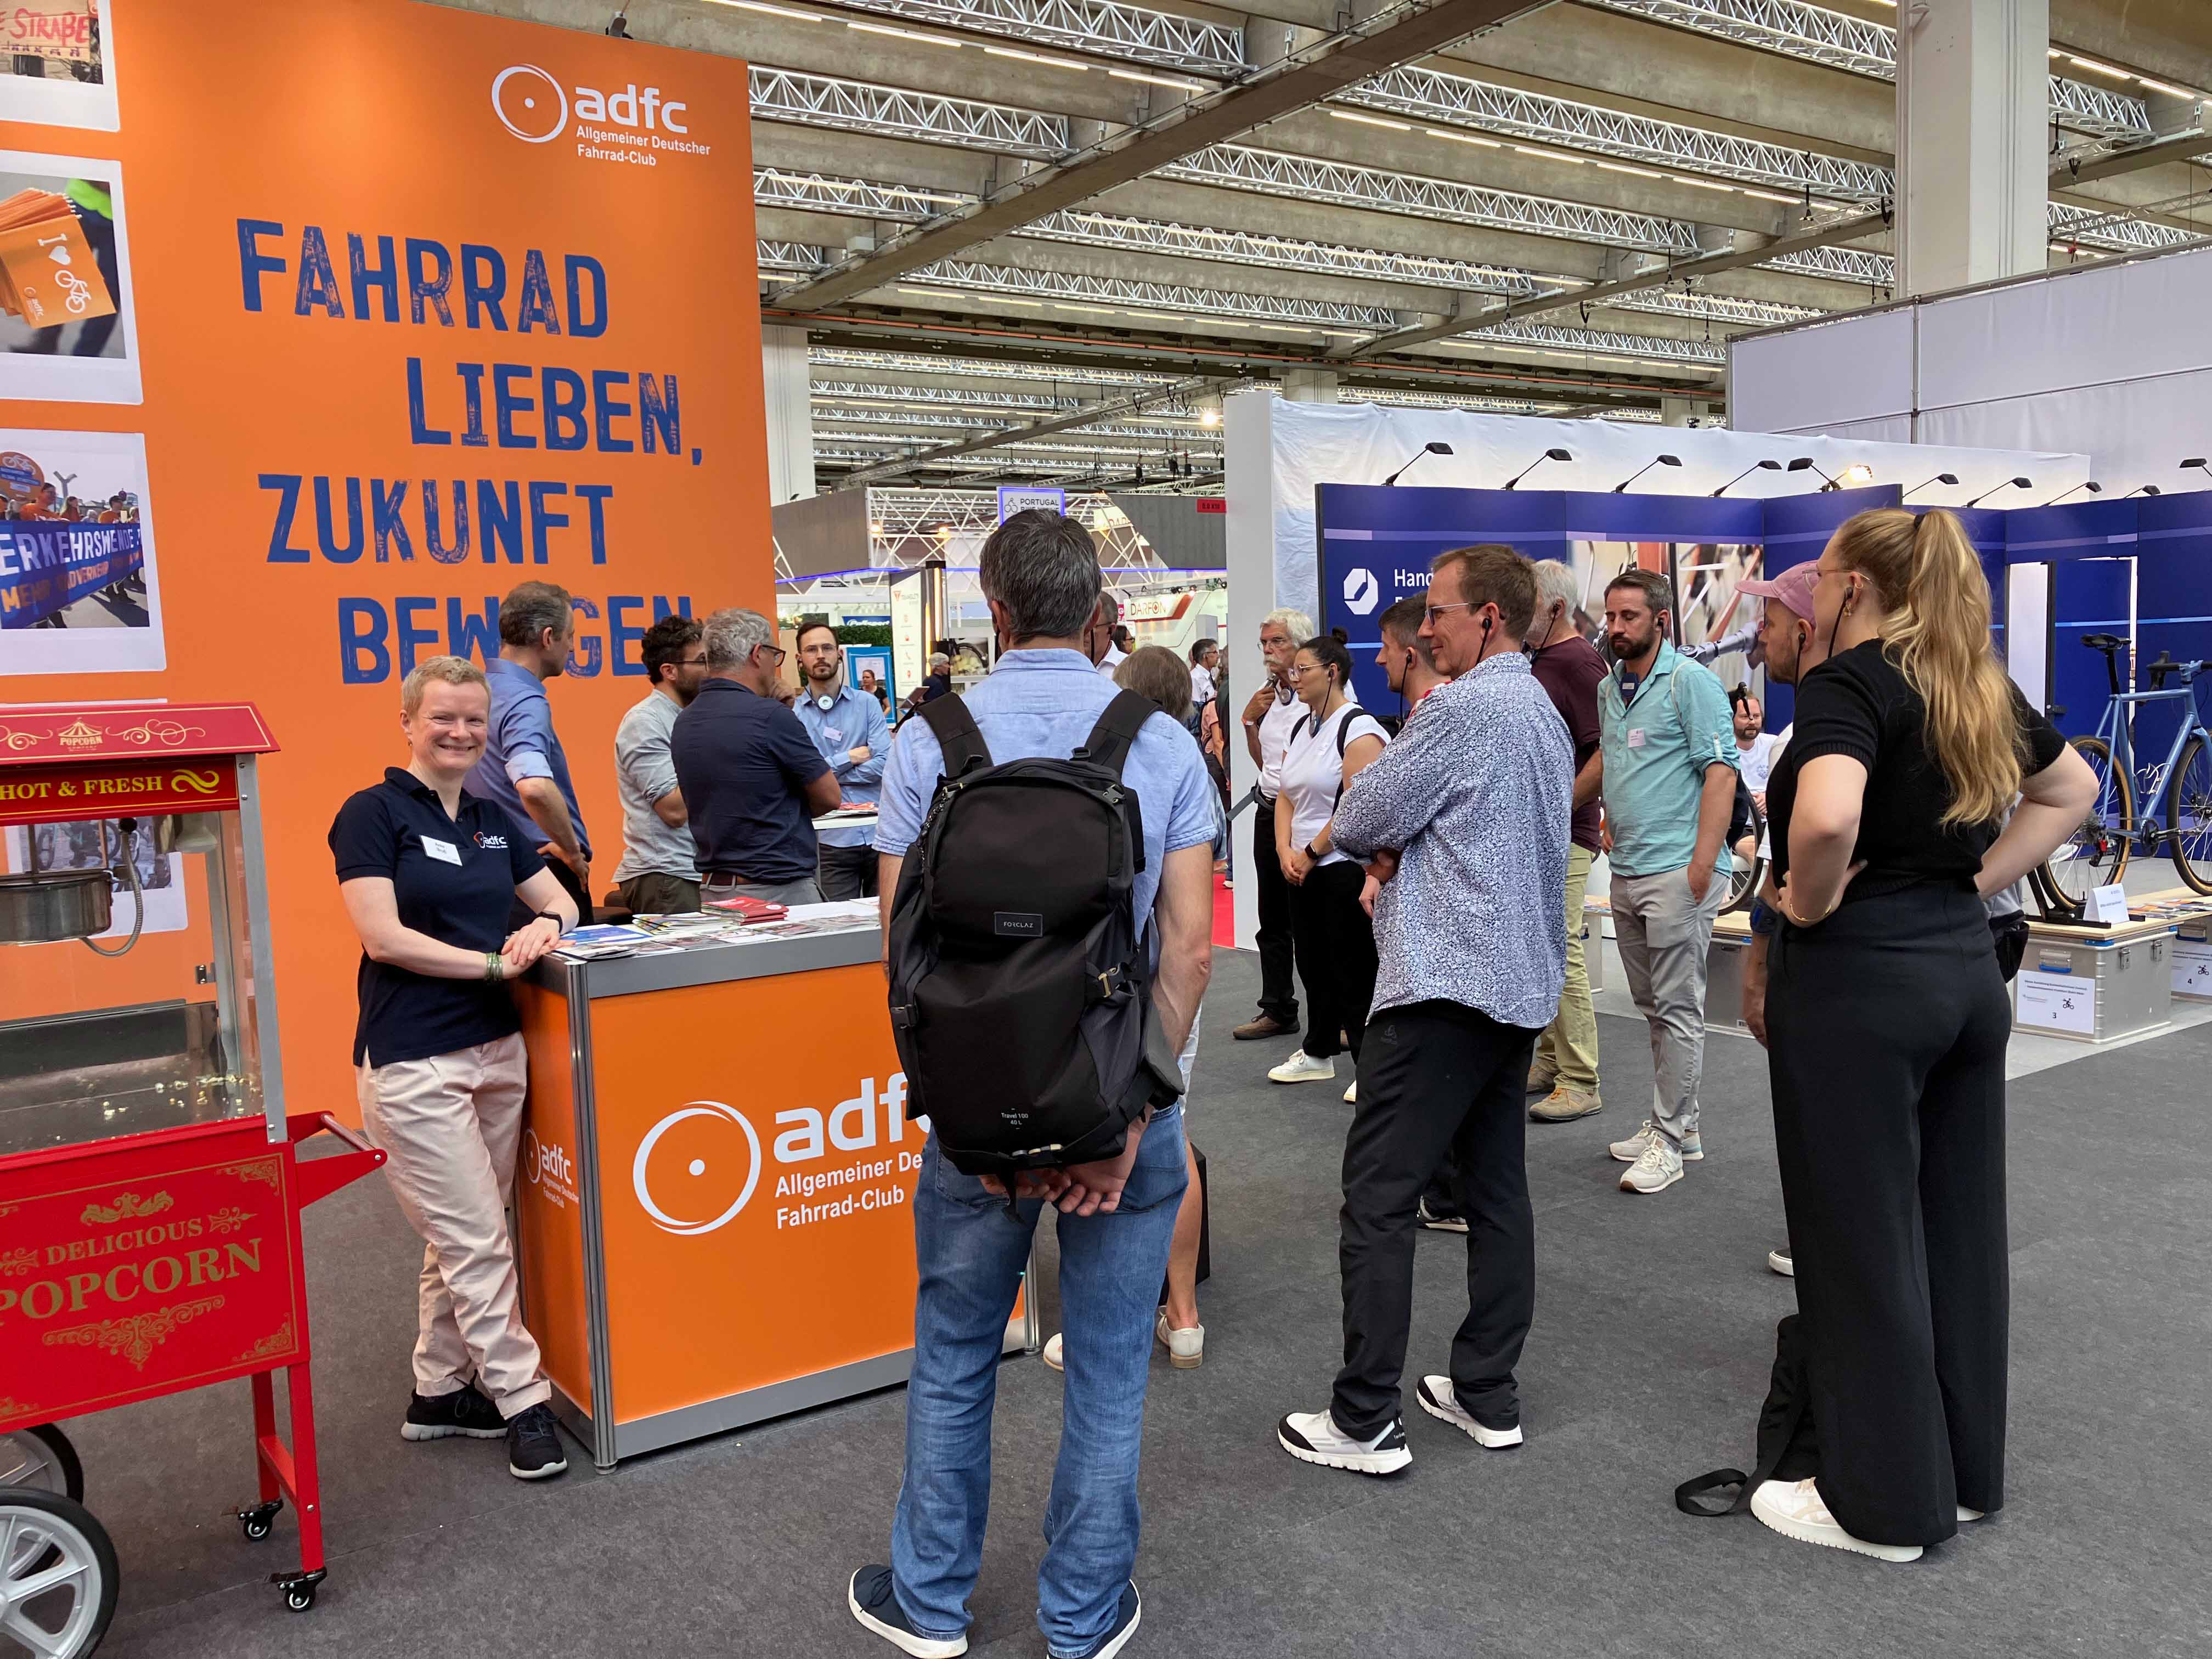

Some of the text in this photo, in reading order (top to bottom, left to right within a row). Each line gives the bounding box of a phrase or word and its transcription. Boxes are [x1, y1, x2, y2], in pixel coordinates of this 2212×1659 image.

[574, 84, 687, 133] adfc
[577, 125, 711, 155] Allgemeiner Deutscher
[577, 144, 656, 166] Fahrrad-Club
[236, 218, 608, 338] FAHRRAD
[406, 357, 703, 466] LIEBEN,
[258, 473, 613, 565] ZUKUNFT
[1131, 601, 1166, 616] DARFON
[59, 736, 103, 746] POPCORN
[0, 776, 163, 800] HOT & FRESH
[483, 836, 507, 845] adfc
[774, 1071, 931, 1164] adf
[541, 1143, 572, 1186] adfc
[775, 1151, 923, 1198] Allgemeiner De
[776, 1184, 905, 1229] Fahrrad-Club
[46, 1218, 203, 1266] DELICIOUS
